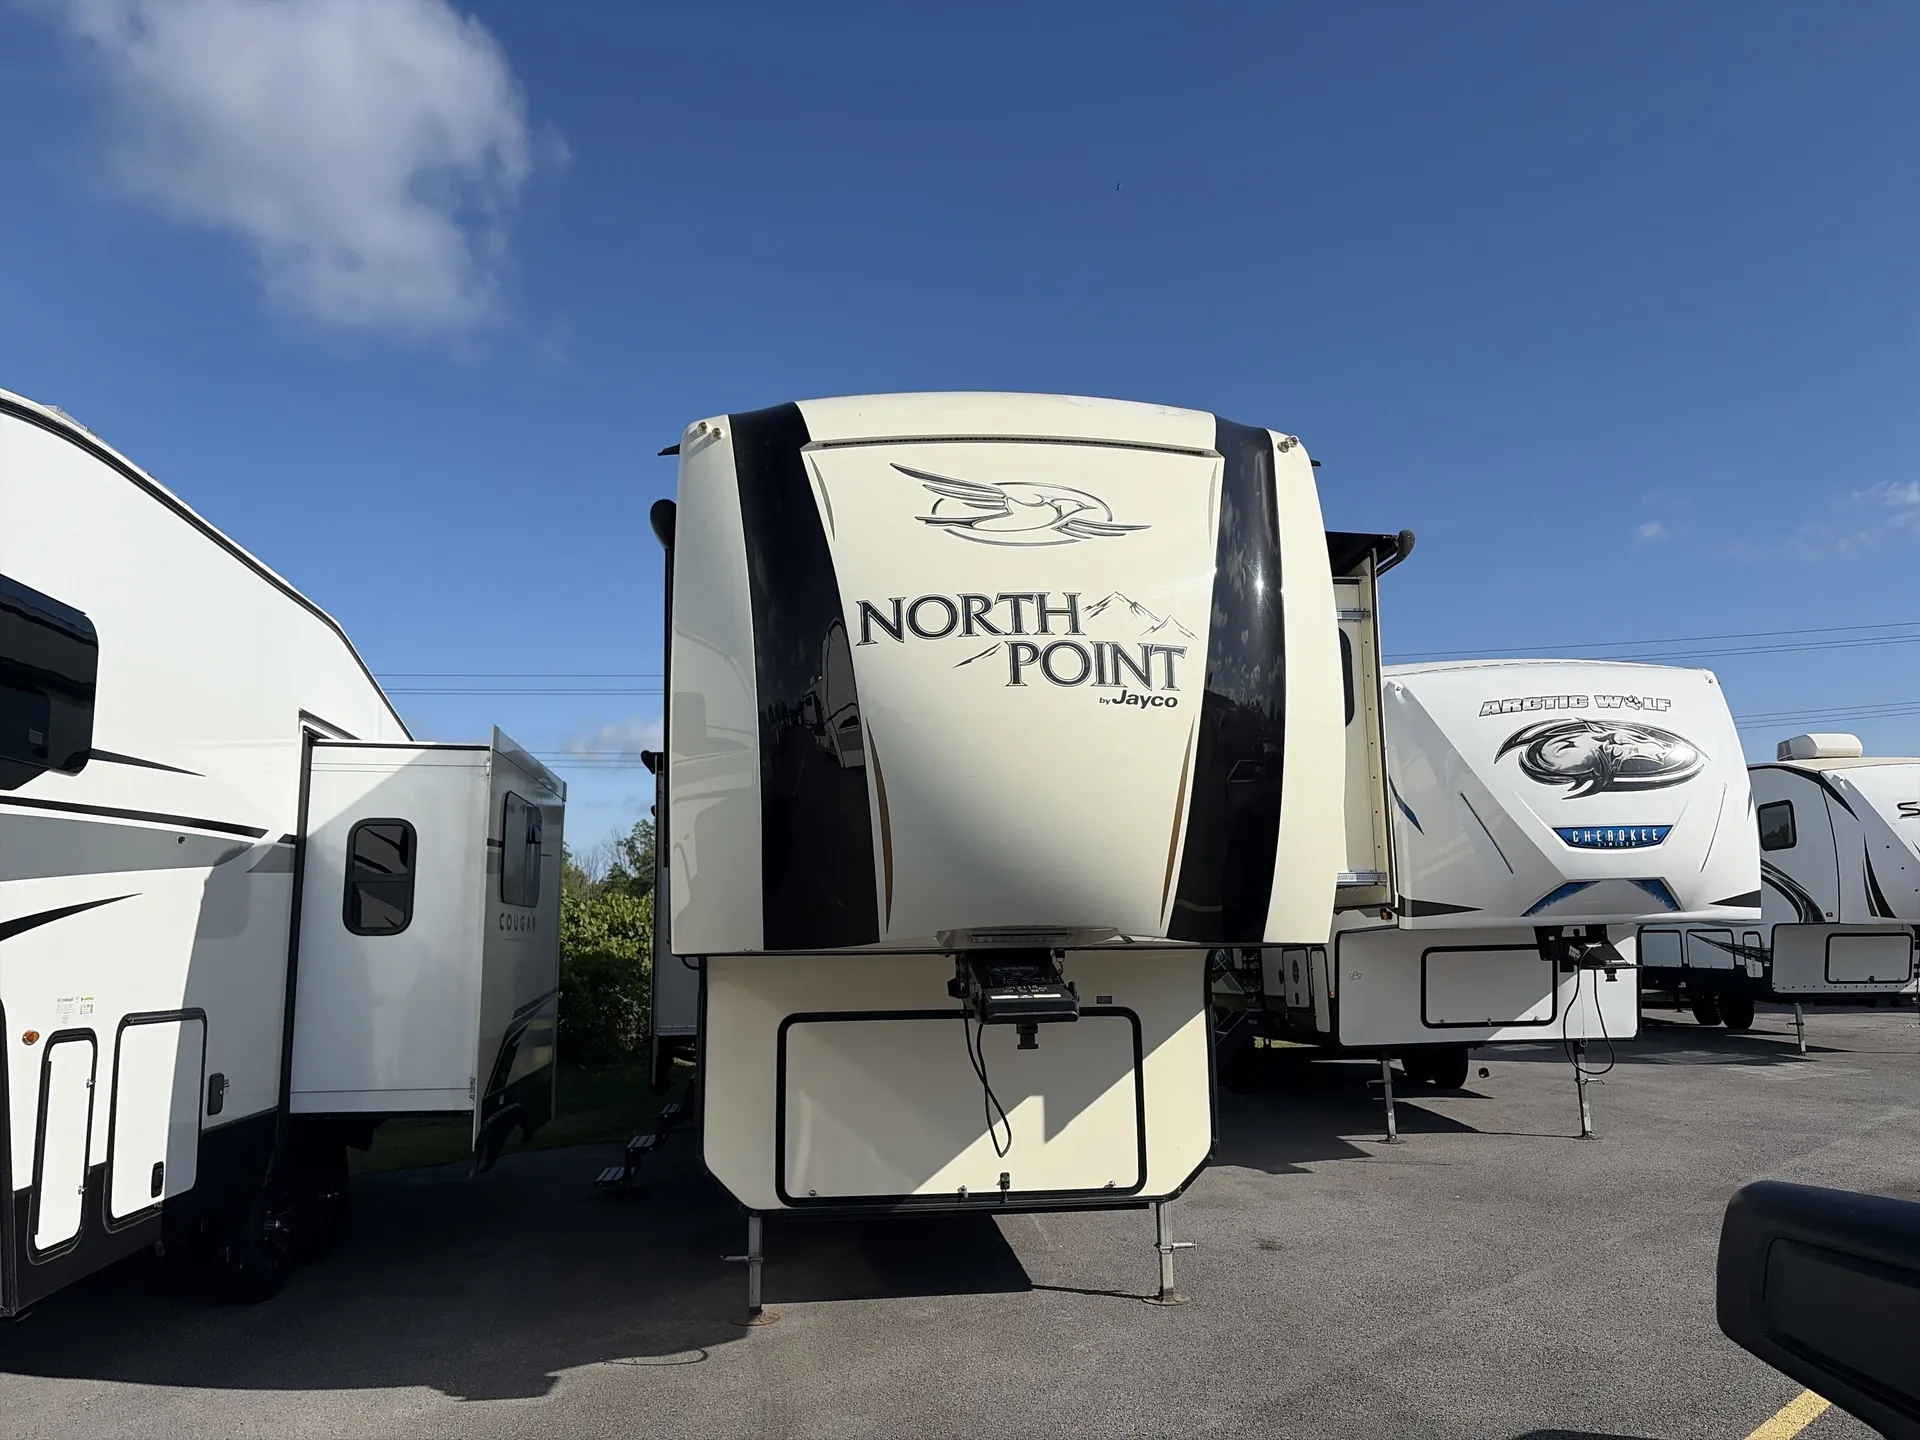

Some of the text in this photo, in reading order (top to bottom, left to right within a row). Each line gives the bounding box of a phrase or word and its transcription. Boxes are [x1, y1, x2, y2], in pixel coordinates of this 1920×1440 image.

[856, 592, 1087, 646] NORTH
[1004, 640, 1187, 691] POINT
[1099, 690, 1178, 709] by Jayco
[1479, 695, 1589, 717] ARCTIC
[1572, 828, 1659, 843] CHEROKEE
[500, 913, 536, 932] COUGAR
